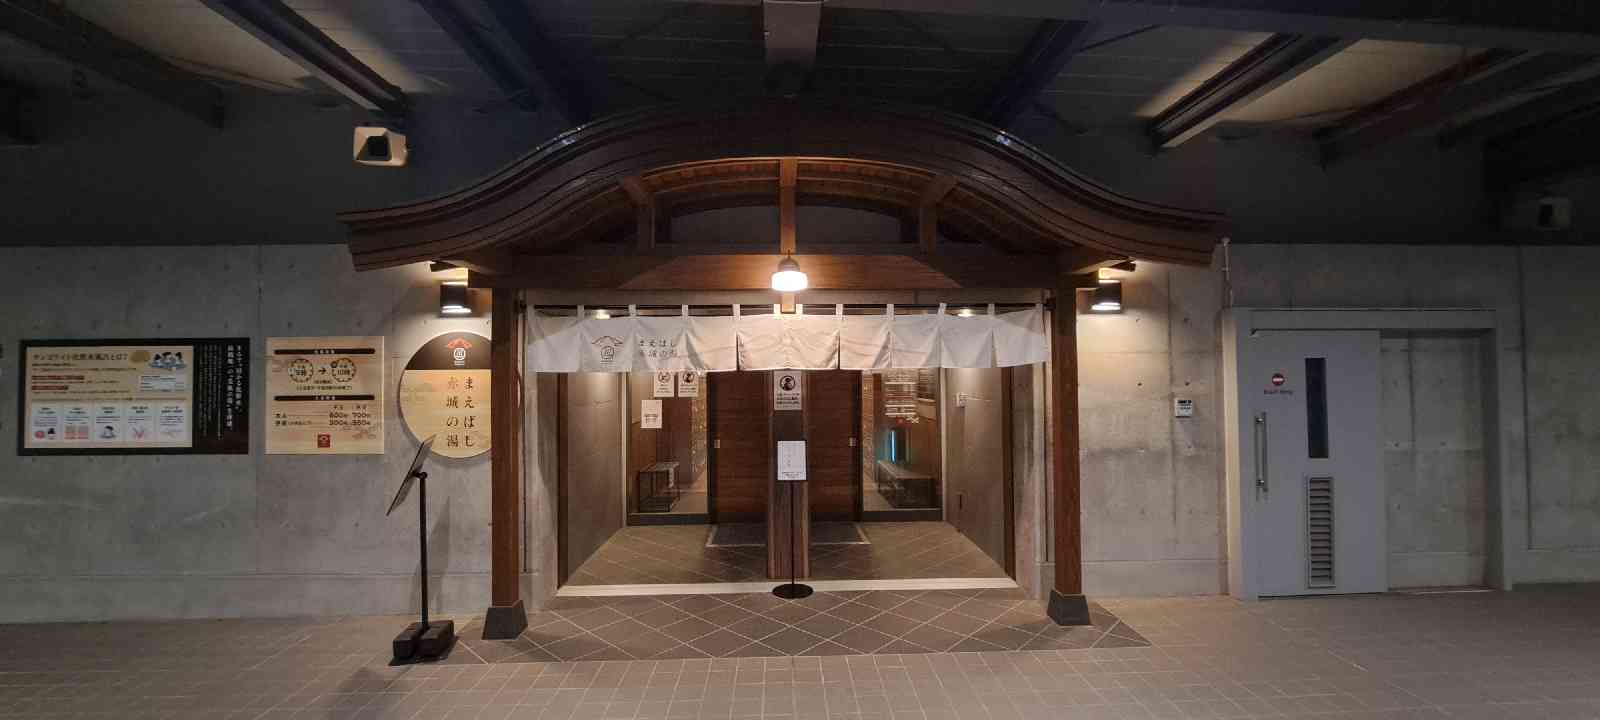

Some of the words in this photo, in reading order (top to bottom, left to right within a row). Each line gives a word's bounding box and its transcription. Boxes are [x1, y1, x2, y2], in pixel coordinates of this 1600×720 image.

[446, 376, 459, 447] 赤城の湯
[464, 376, 477, 447] まえばし
